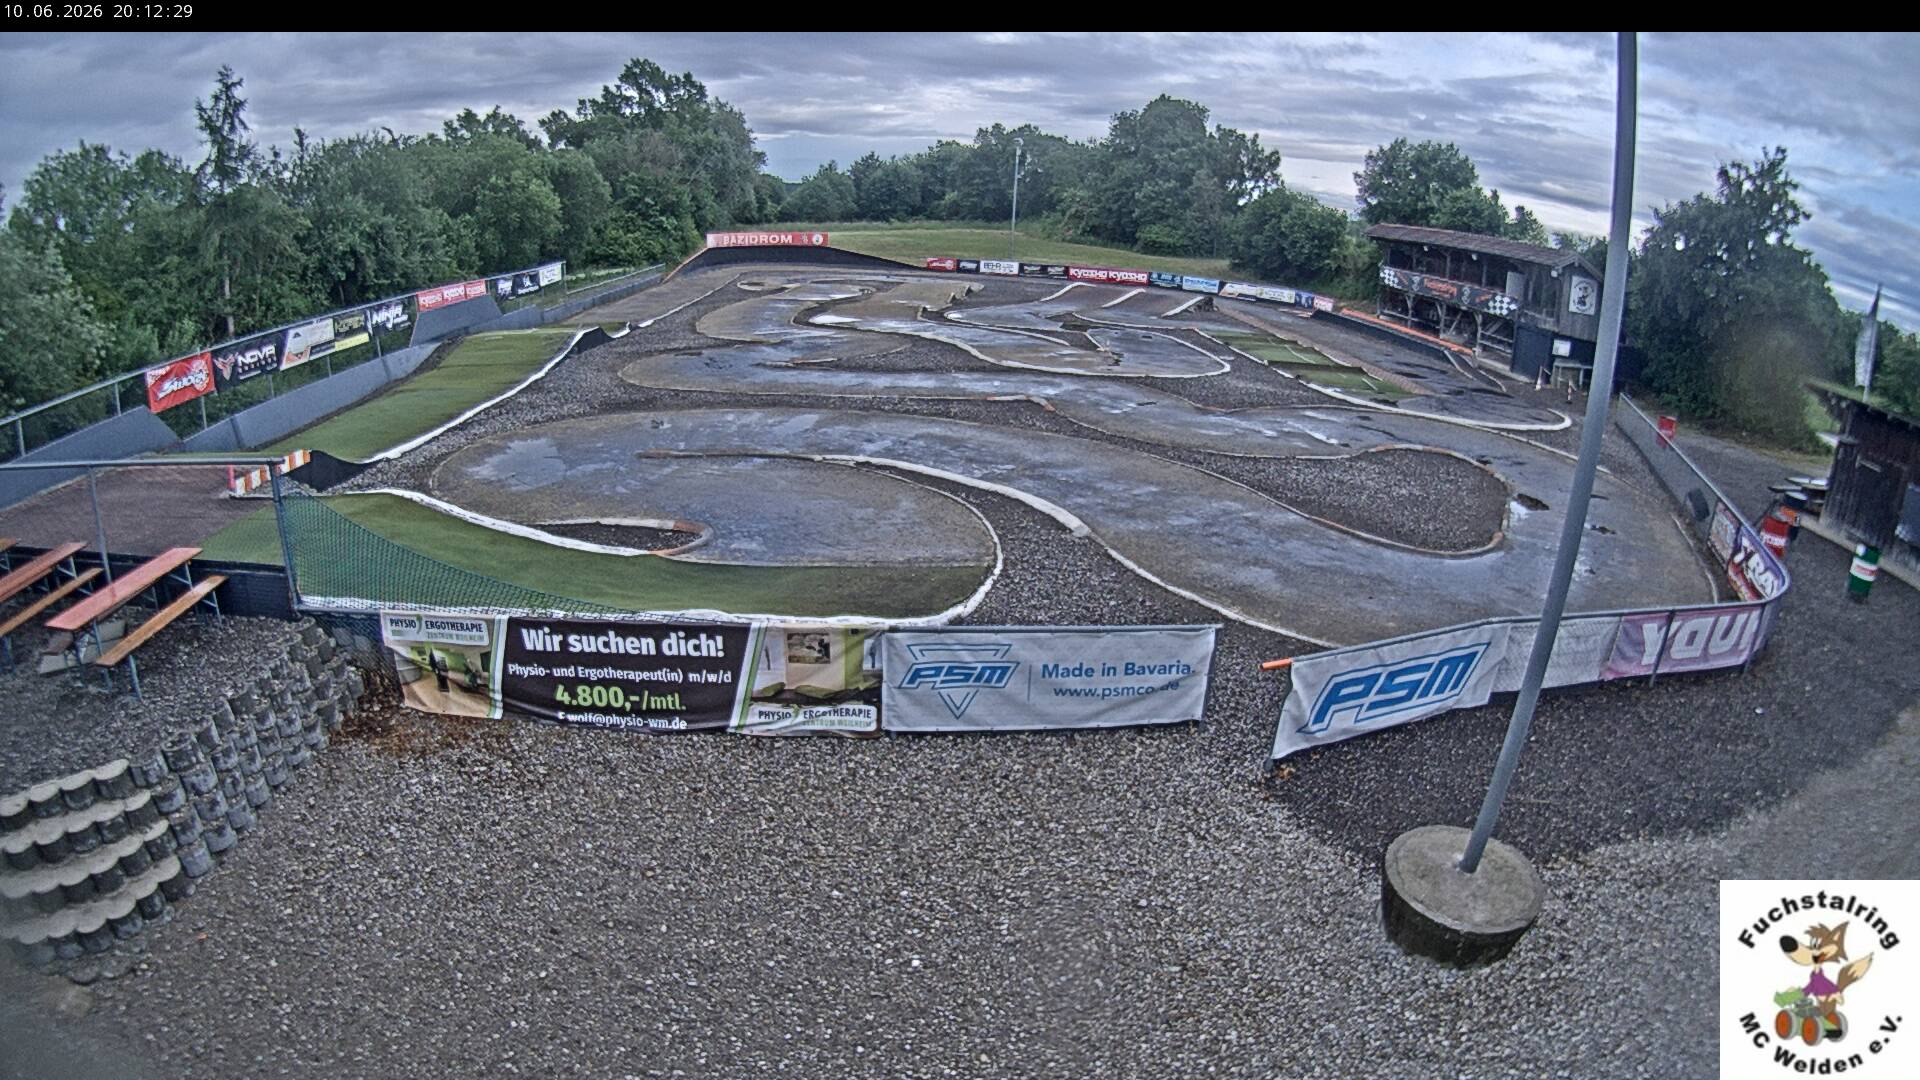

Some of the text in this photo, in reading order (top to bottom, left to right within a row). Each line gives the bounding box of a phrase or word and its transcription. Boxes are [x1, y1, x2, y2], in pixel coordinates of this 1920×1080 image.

[237, 344, 276, 366] NOVA
[390, 618, 483, 632] PHYSIO ERGOTHERAPIE
[520, 627, 725, 657] Wir suchen dich!
[508, 663, 732, 683] Physio- und Ergotherapeut(in) m/w/d
[904, 664, 1014, 686] PSM
[1041, 663, 1094, 680] Made
[1101, 663, 1116, 677] in
[1311, 650, 1480, 726] PSM
[558, 711, 687, 729] Fwolf@physio-wm.de
[758, 710, 792, 720] PHYSIO
